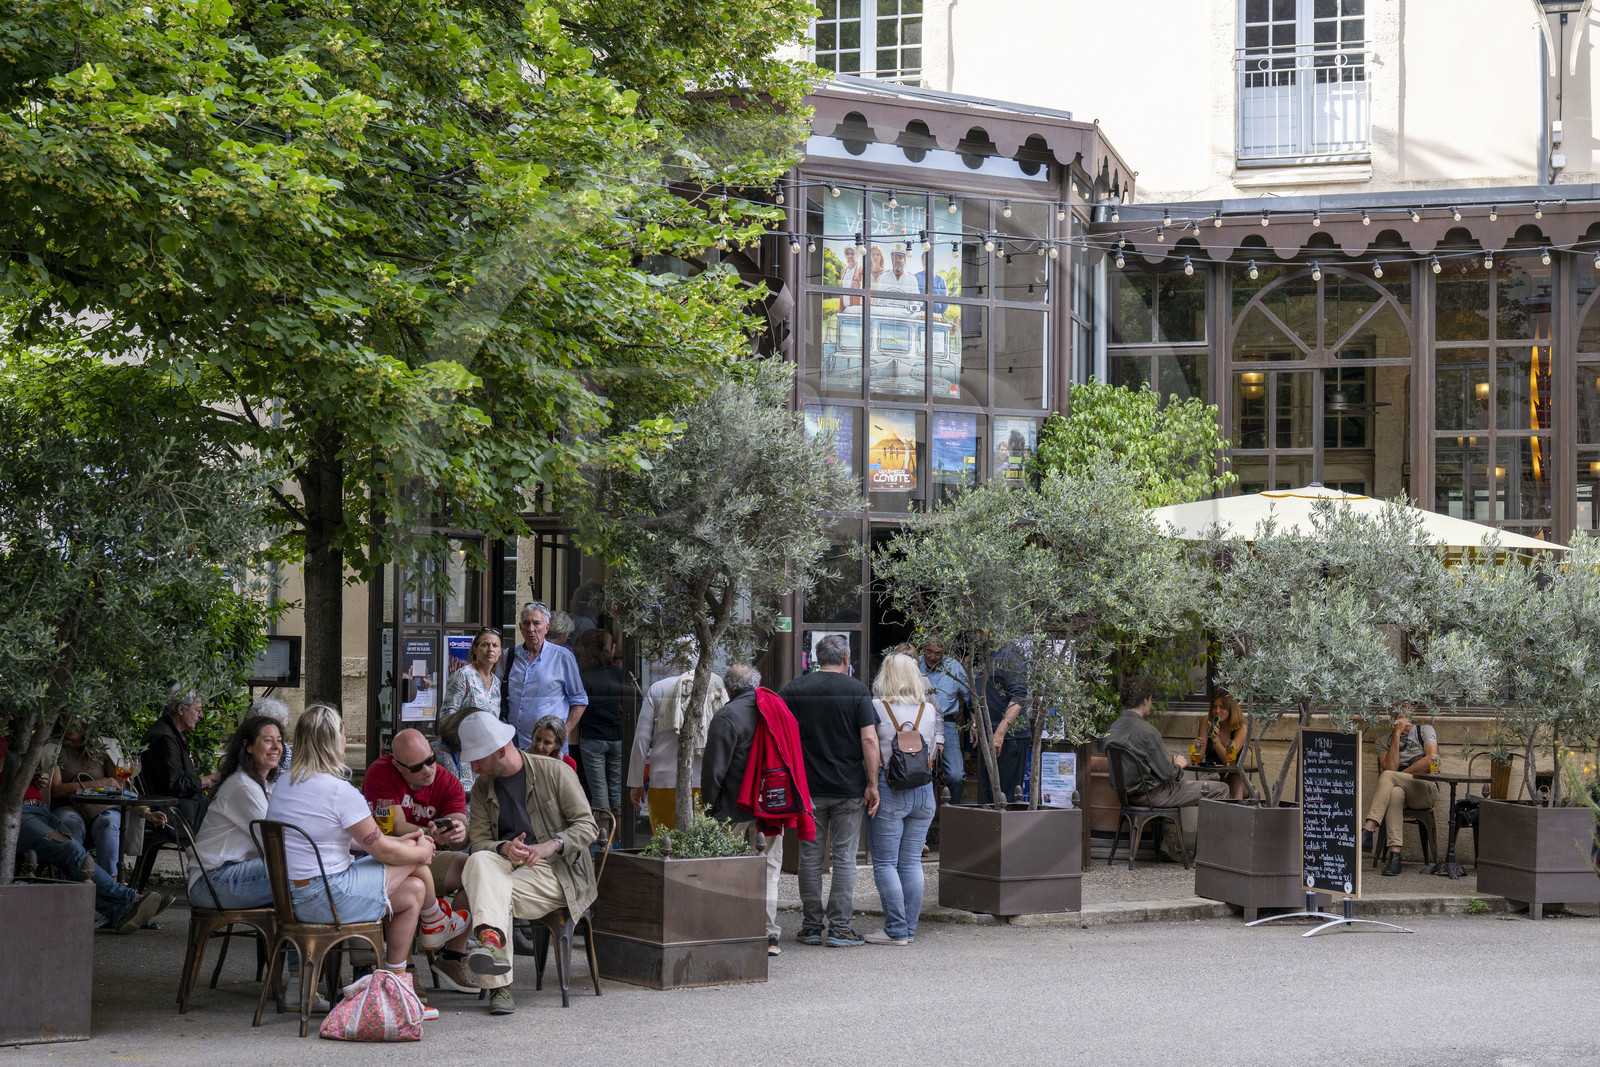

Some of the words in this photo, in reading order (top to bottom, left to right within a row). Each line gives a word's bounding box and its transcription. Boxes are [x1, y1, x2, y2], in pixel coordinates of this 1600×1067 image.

[882, 202, 928, 222] PETIT
[845, 216, 944, 242] VADROUIE
[817, 416, 840, 431] VIEUX
[873, 473, 911, 484] COYOTE
[1315, 738, 1333, 749] MENU
